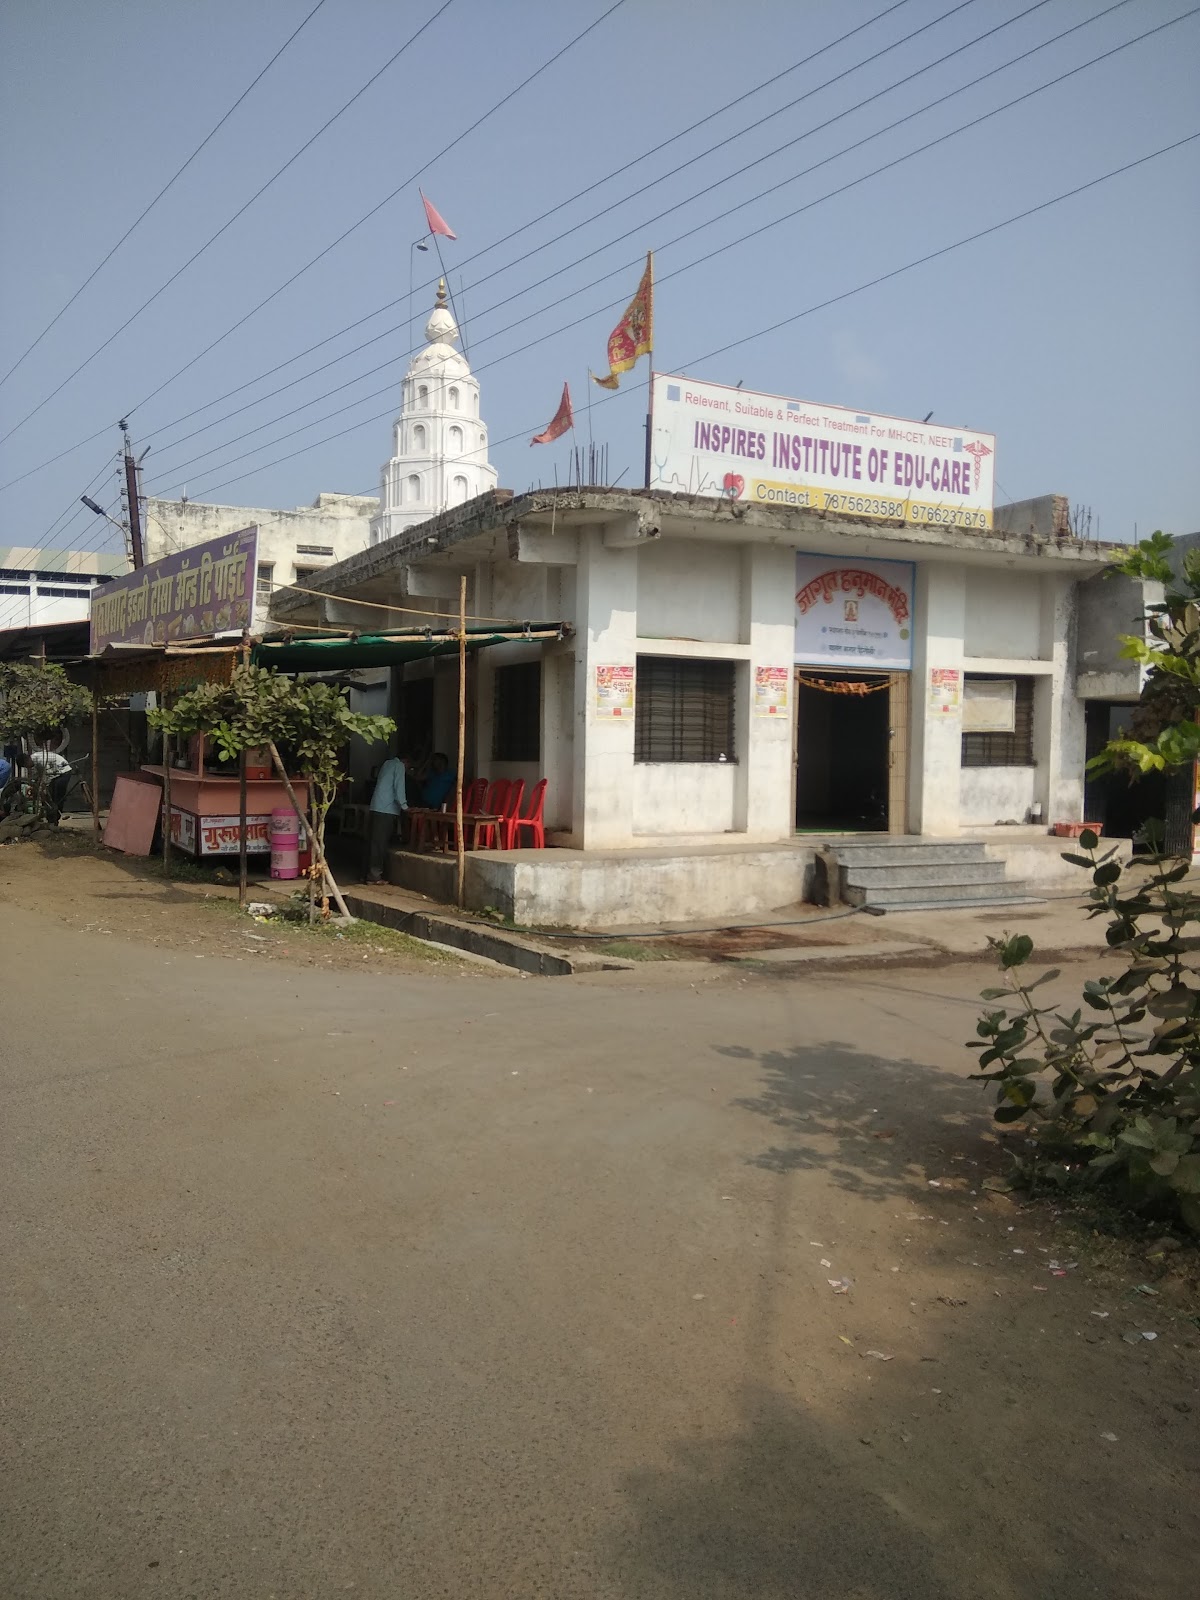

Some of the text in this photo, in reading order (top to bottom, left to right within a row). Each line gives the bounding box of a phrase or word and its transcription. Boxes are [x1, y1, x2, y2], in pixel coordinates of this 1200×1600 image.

[686, 392, 952, 448] Relevant, Suitable & Perfect Treatment For MH-CET, NEET
[694, 421, 970, 495] INSPIRES INSTITUTE OF EDU-CARE
[756, 484, 810, 506] Contact
[128, 574, 149, 627] इडली
[840, 569, 890, 600] हनुमान
